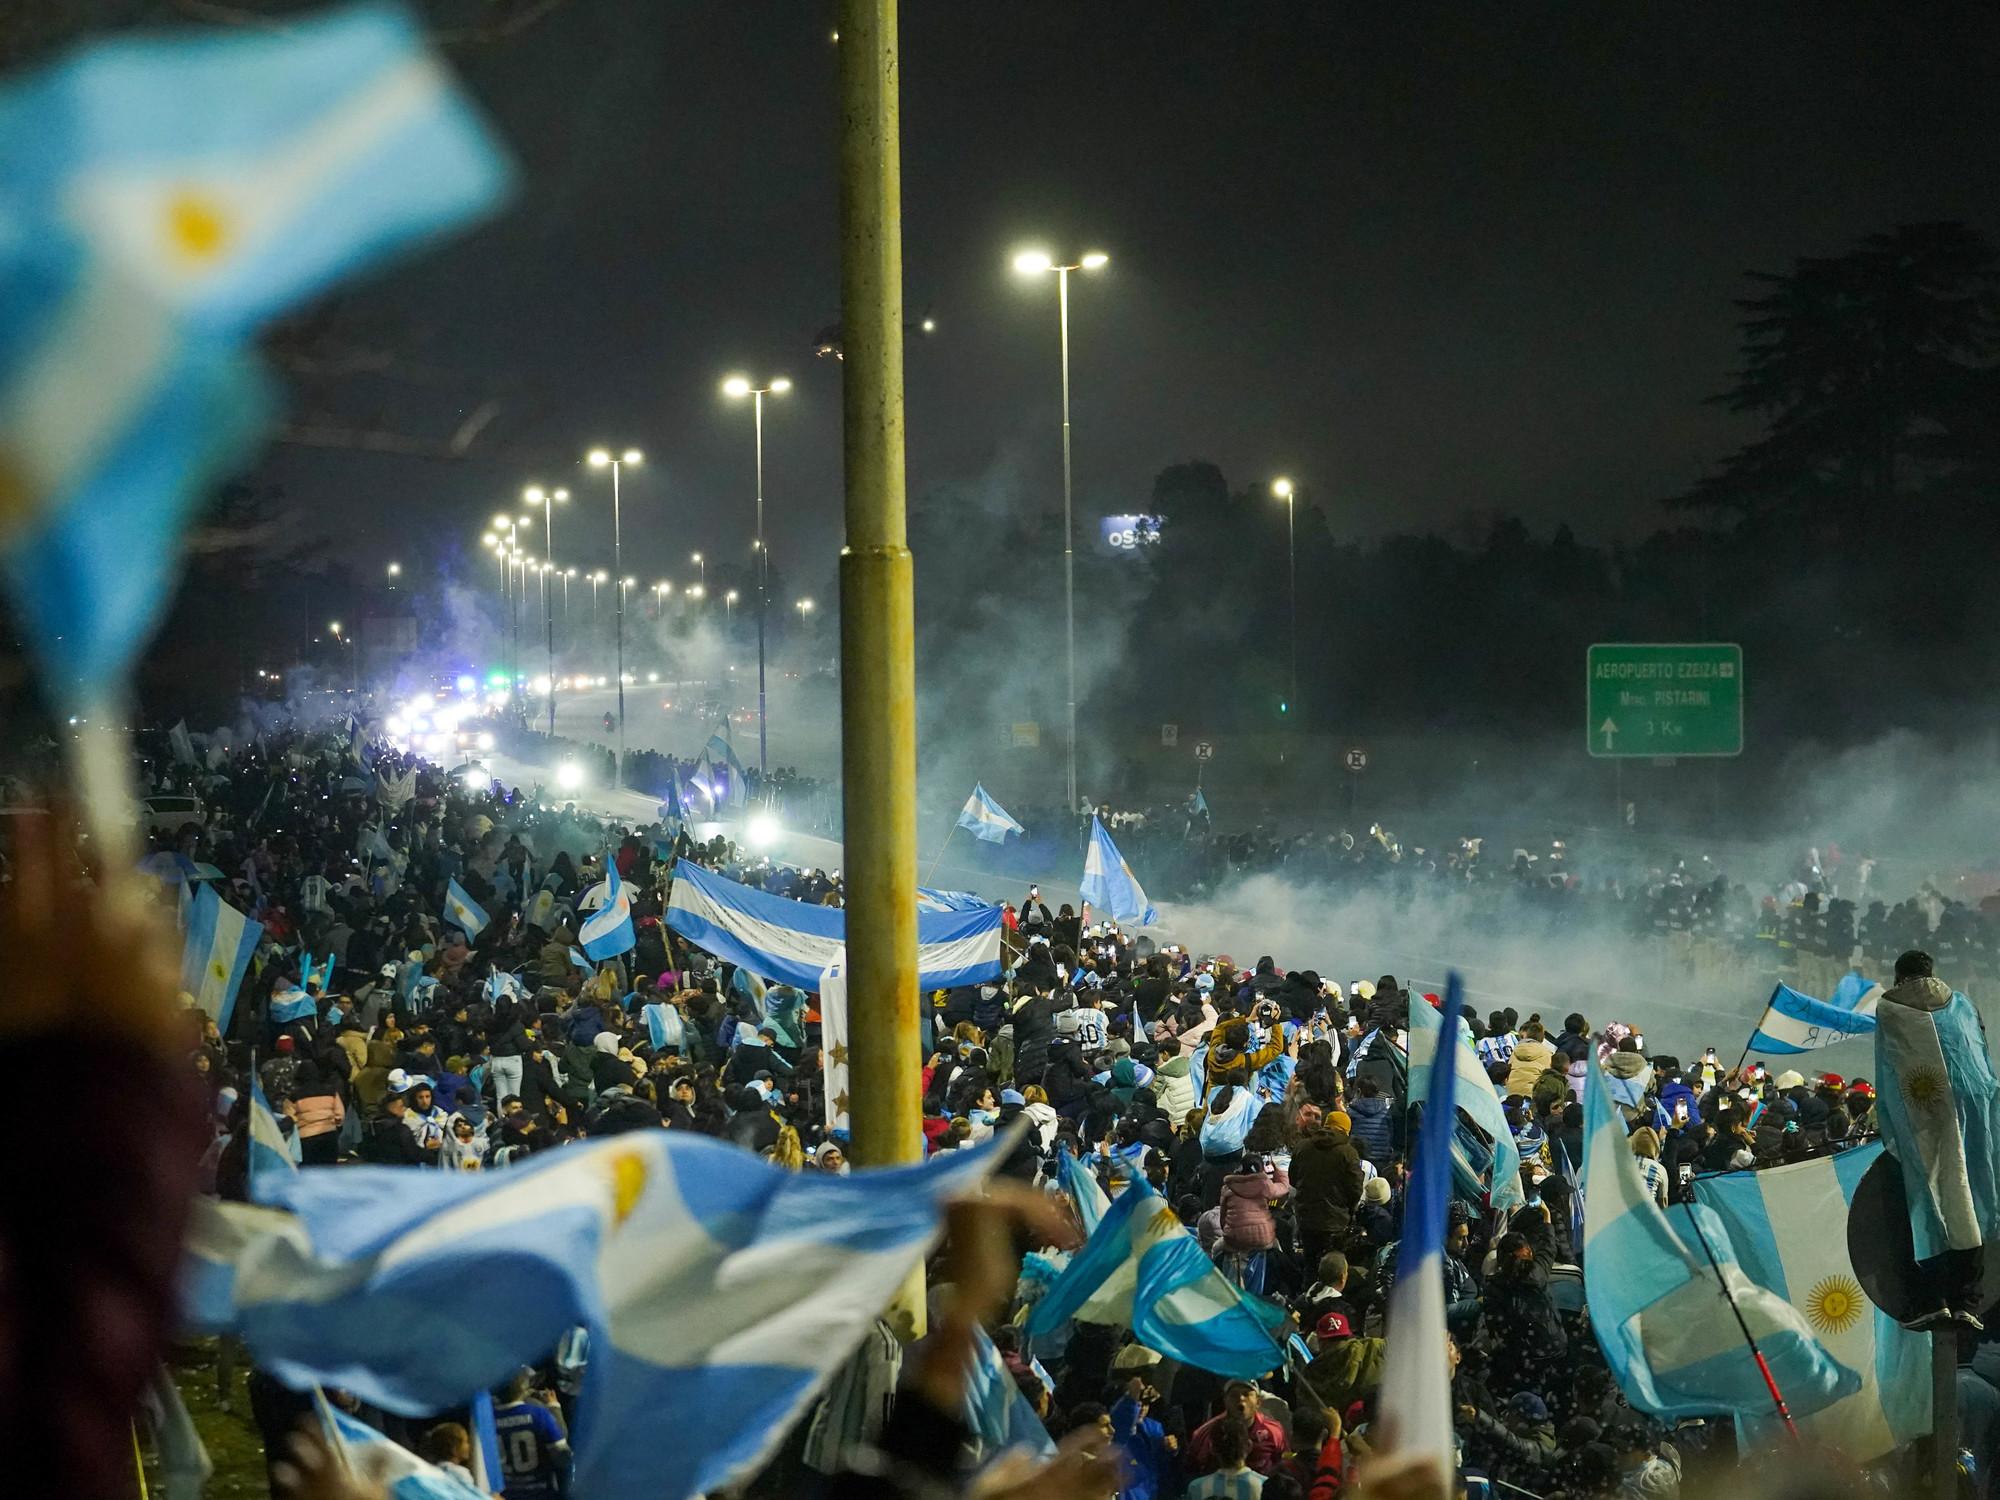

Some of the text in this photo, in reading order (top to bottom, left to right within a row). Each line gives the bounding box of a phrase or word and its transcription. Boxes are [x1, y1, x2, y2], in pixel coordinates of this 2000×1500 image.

[1596, 663, 1718, 679] AEROPUERTO EZEIZA
[1654, 691, 1711, 705] PISTARINI
[1647, 721, 1654, 736] 3
[1078, 1023, 1099, 1043] 10
[1493, 1045, 1513, 1060] 10
